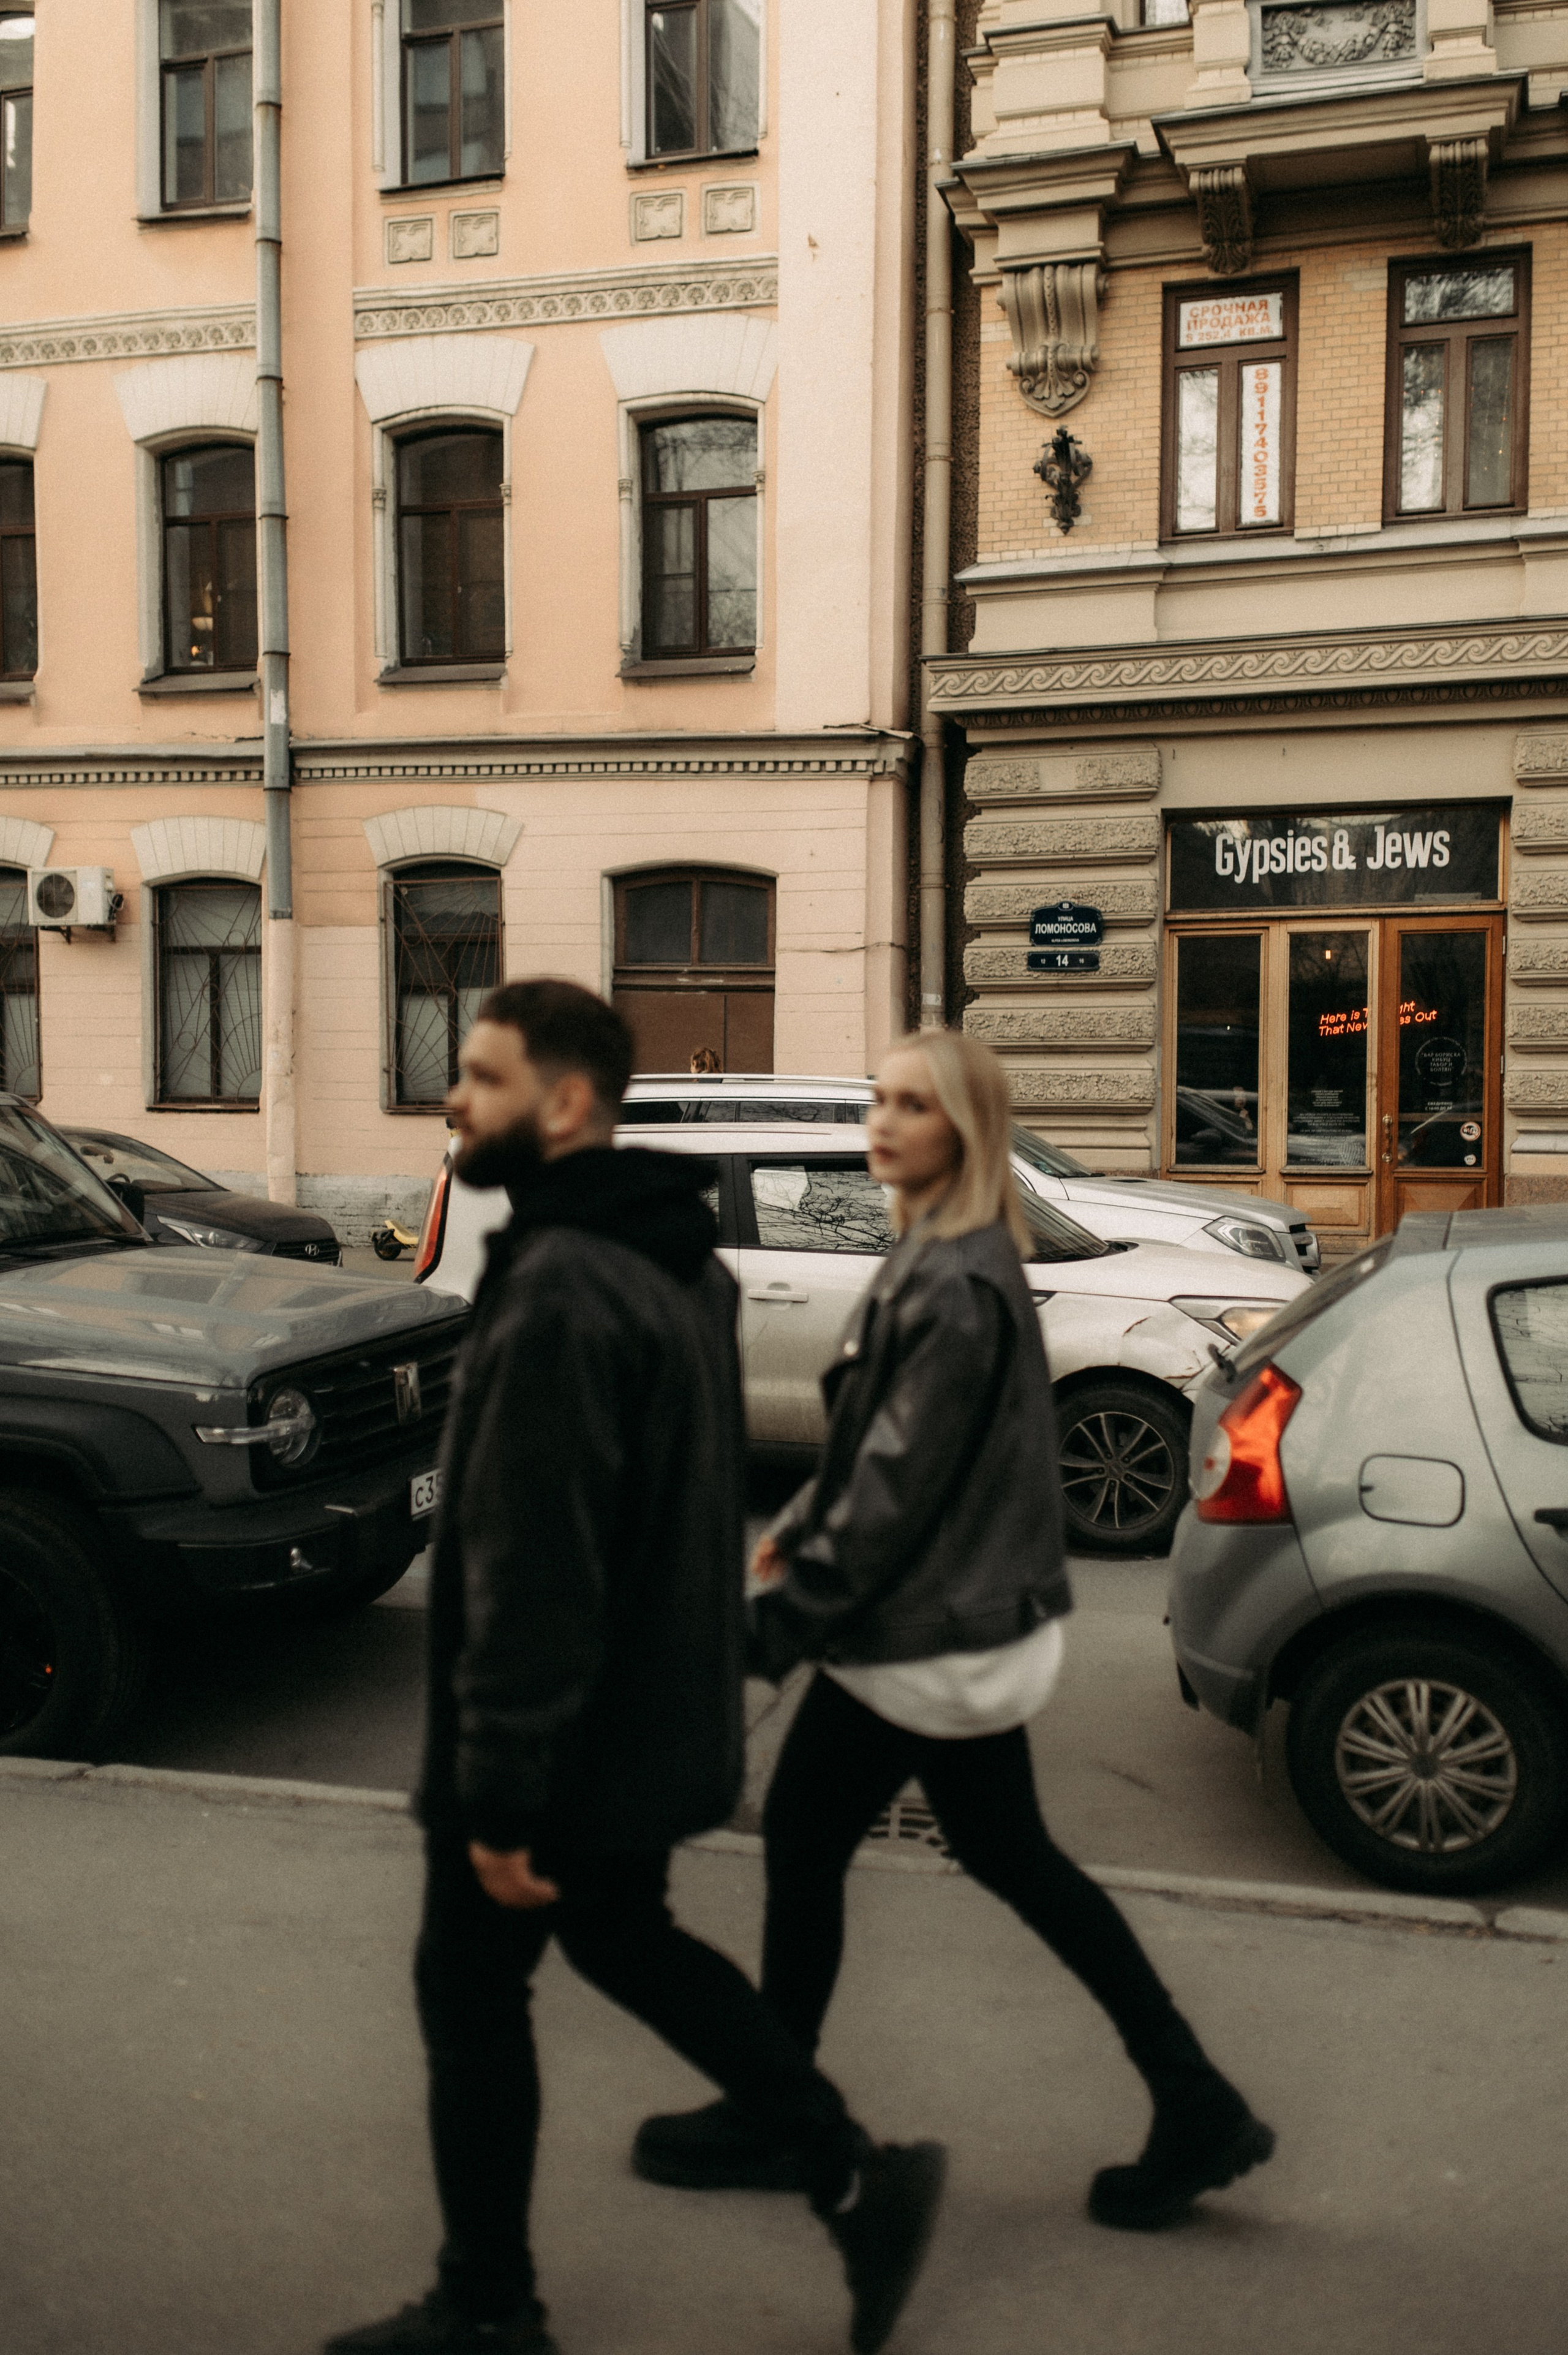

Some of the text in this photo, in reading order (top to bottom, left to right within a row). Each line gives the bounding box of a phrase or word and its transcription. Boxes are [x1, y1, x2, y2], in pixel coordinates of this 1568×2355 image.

[1189, 299, 1268, 318] СРОЧНАЯ
[1187, 312, 1270, 331] ПРОДАЖА
[1215, 825, 1450, 884] Gypsies & Jews
[1035, 923, 1097, 934] ЛОМОНОСОВА
[1055, 954, 1069, 967] 14
[1319, 1024, 1344, 1037] That
[1346, 1021, 1368, 1033] Nev
[1415, 1010, 1438, 1023] Out
[1320, 1013, 1347, 1024] Here
[1350, 1010, 1360, 1021] is
